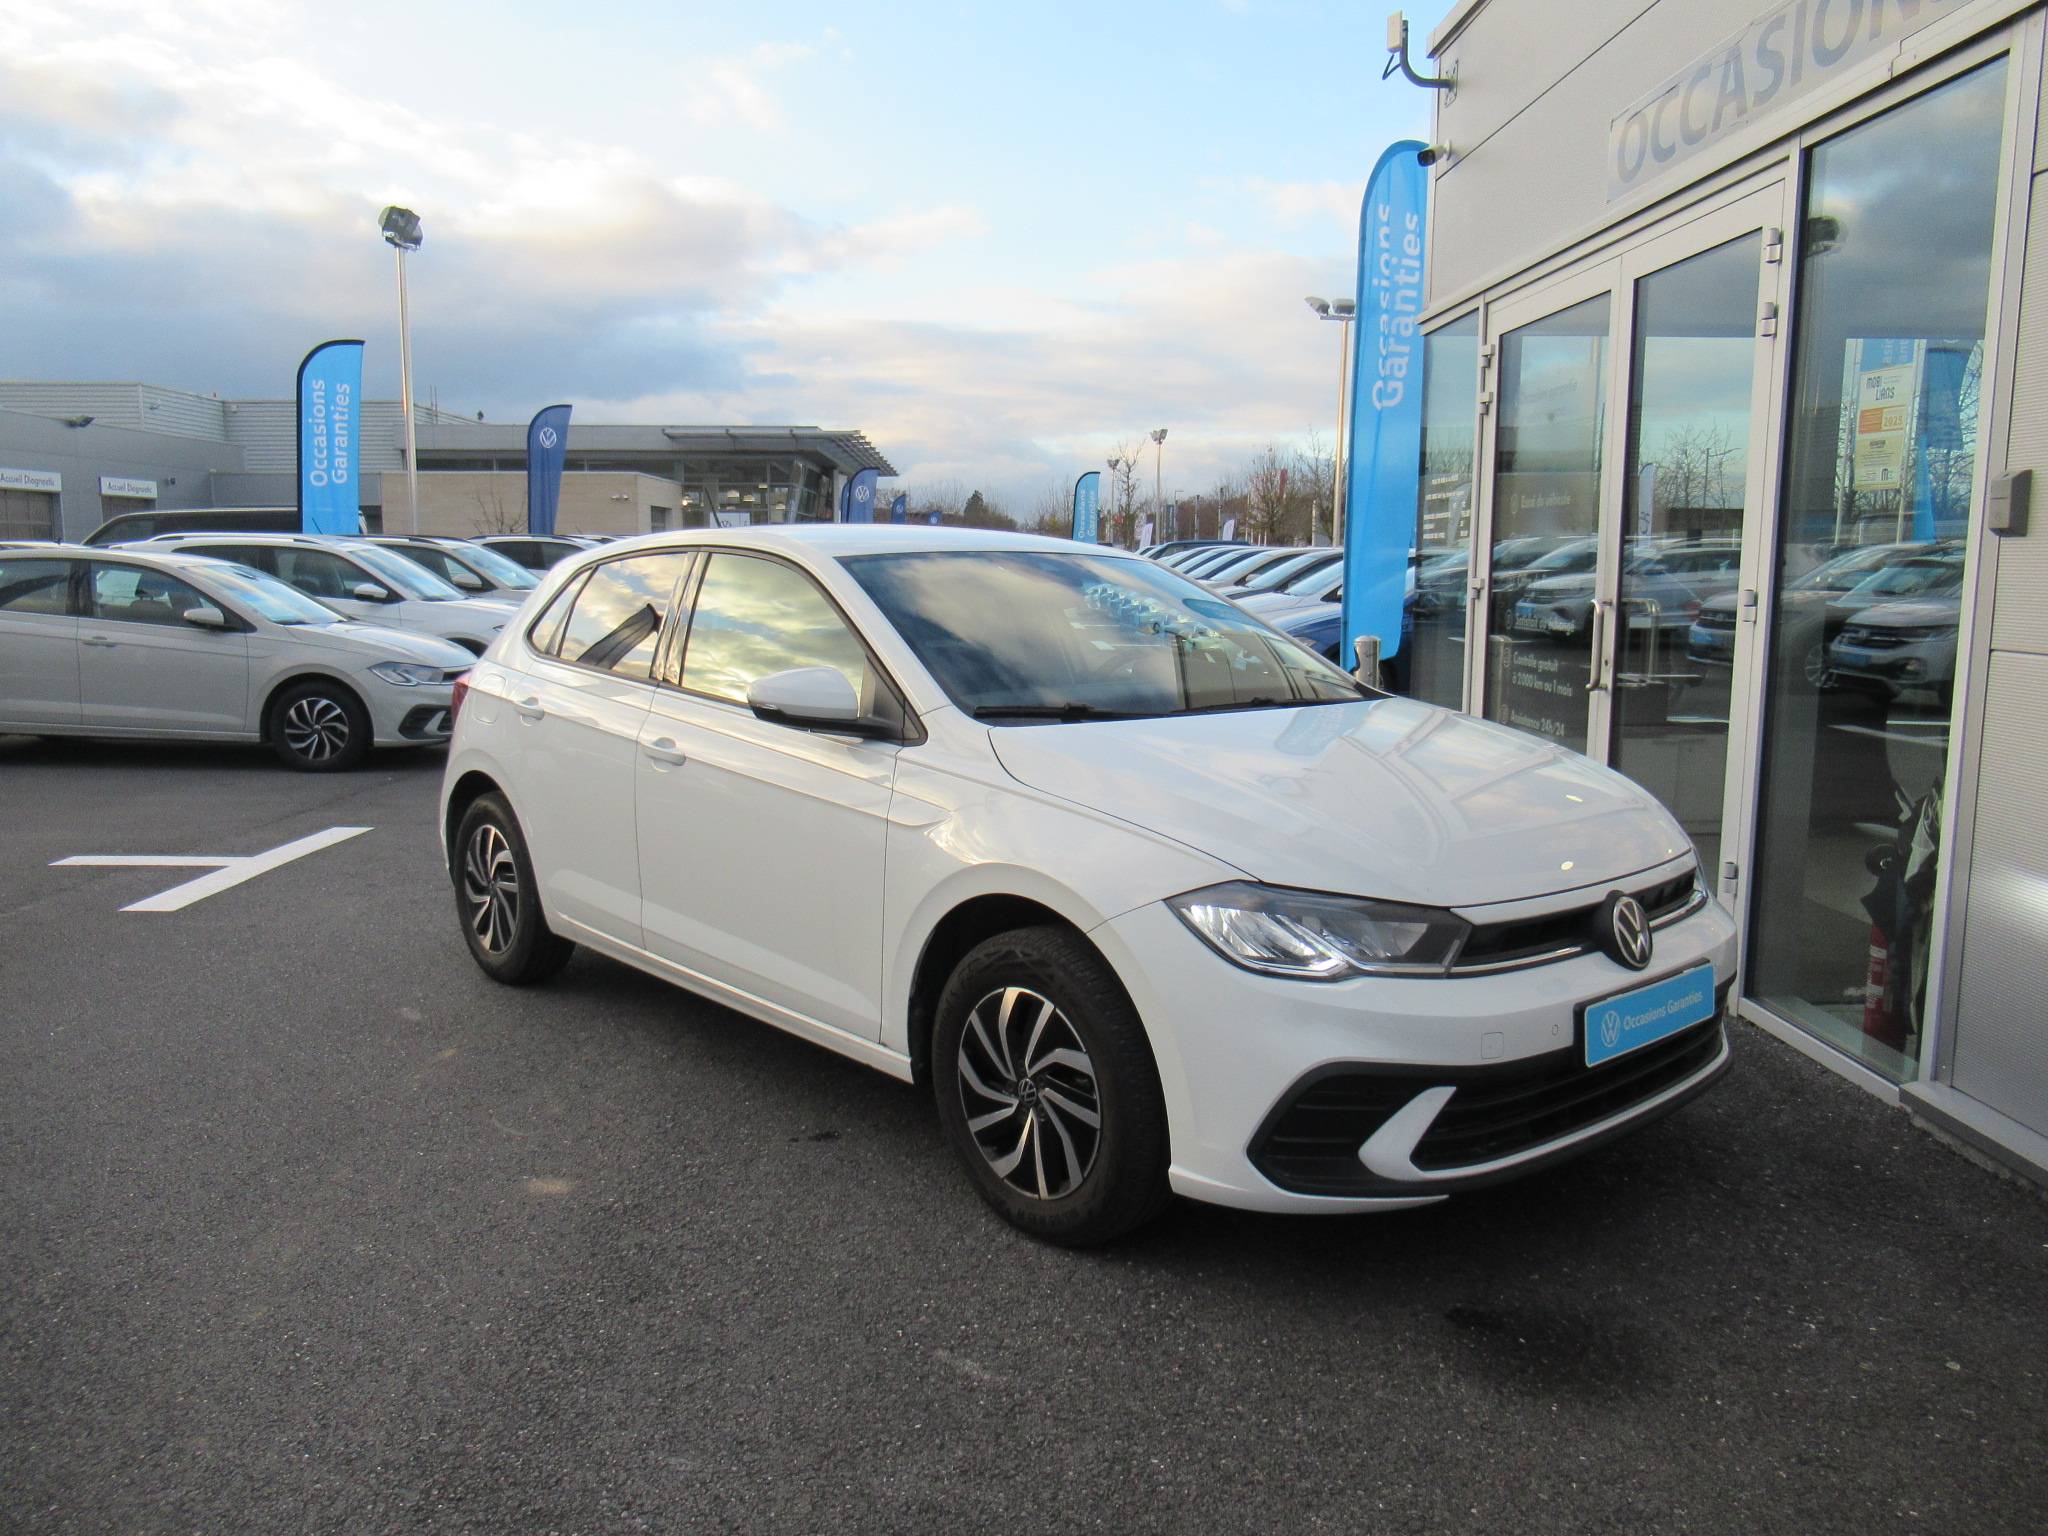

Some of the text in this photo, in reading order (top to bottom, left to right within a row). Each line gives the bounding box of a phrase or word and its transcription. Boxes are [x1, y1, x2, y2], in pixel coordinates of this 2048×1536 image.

[1616, 0, 1945, 184] OCCASIO
[1381, 211, 1421, 407] Garanties
[308, 379, 328, 487] Occasions
[331, 383, 350, 485] Garanties
[1623, 1006, 1666, 1031] Occasions
[1667, 991, 1704, 1014] Garanties
